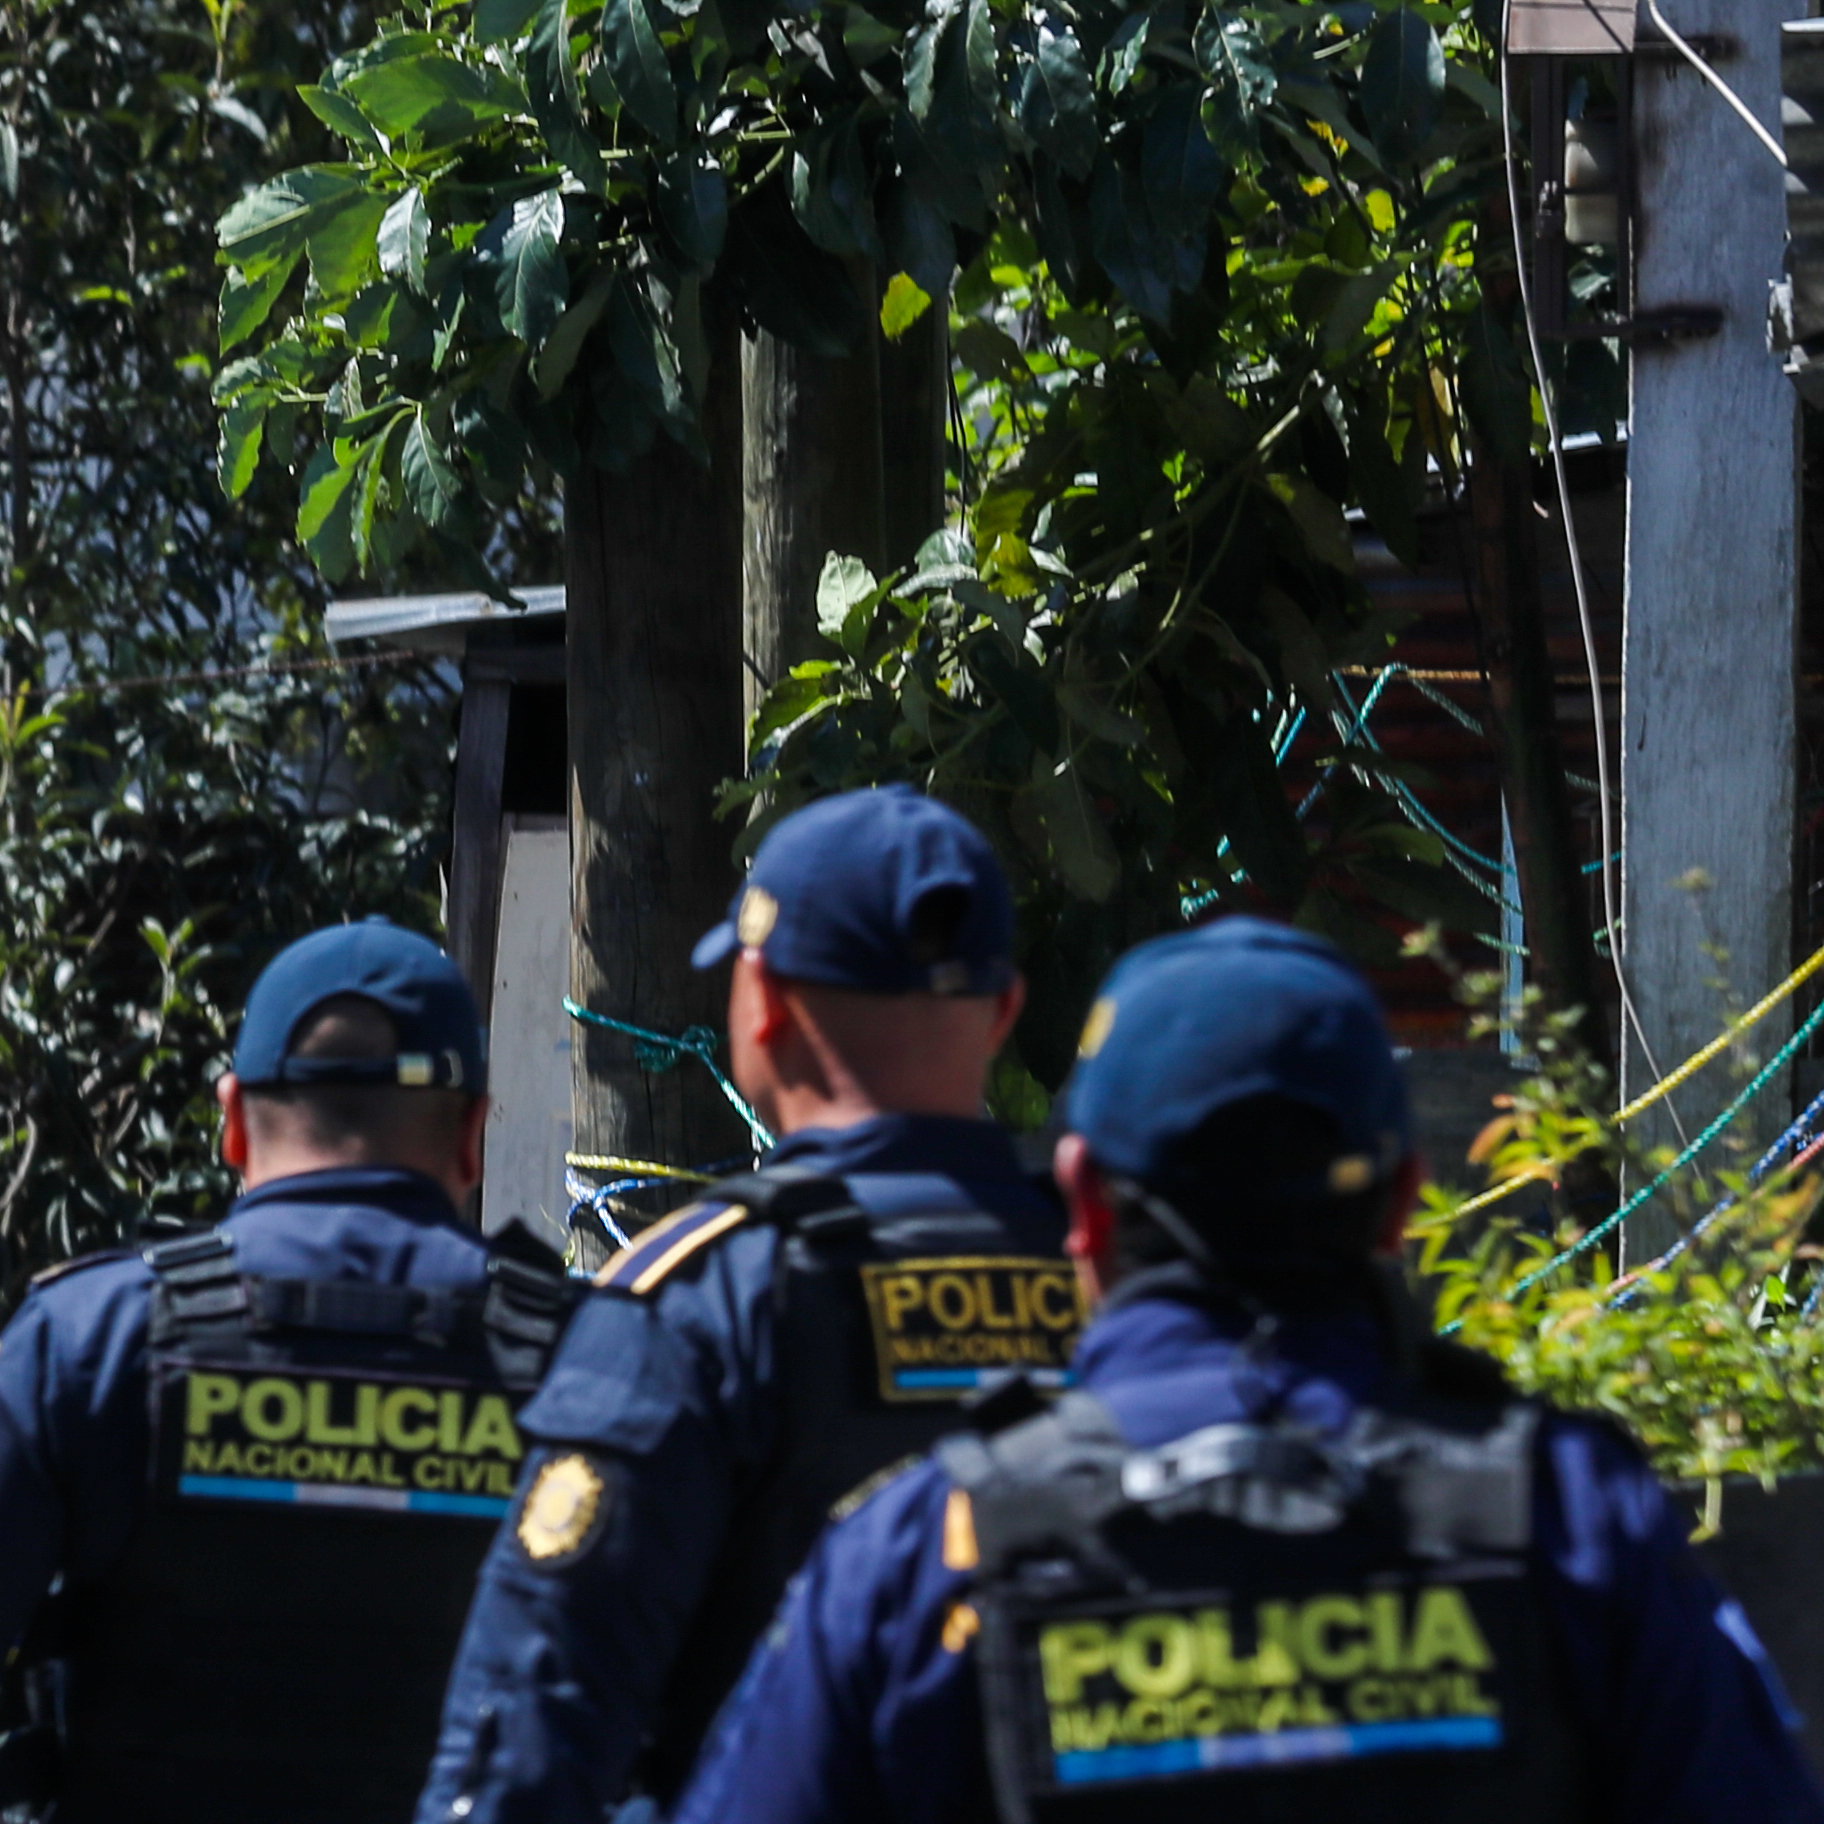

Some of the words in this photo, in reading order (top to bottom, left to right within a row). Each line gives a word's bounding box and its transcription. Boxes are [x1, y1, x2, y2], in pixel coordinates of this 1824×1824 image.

[185, 1371, 522, 1460] POLICIA
[183, 1440, 404, 1487] NACIONAL
[412, 1455, 516, 1497] CIVIL
[1040, 1588, 1495, 1702] POLICIA
